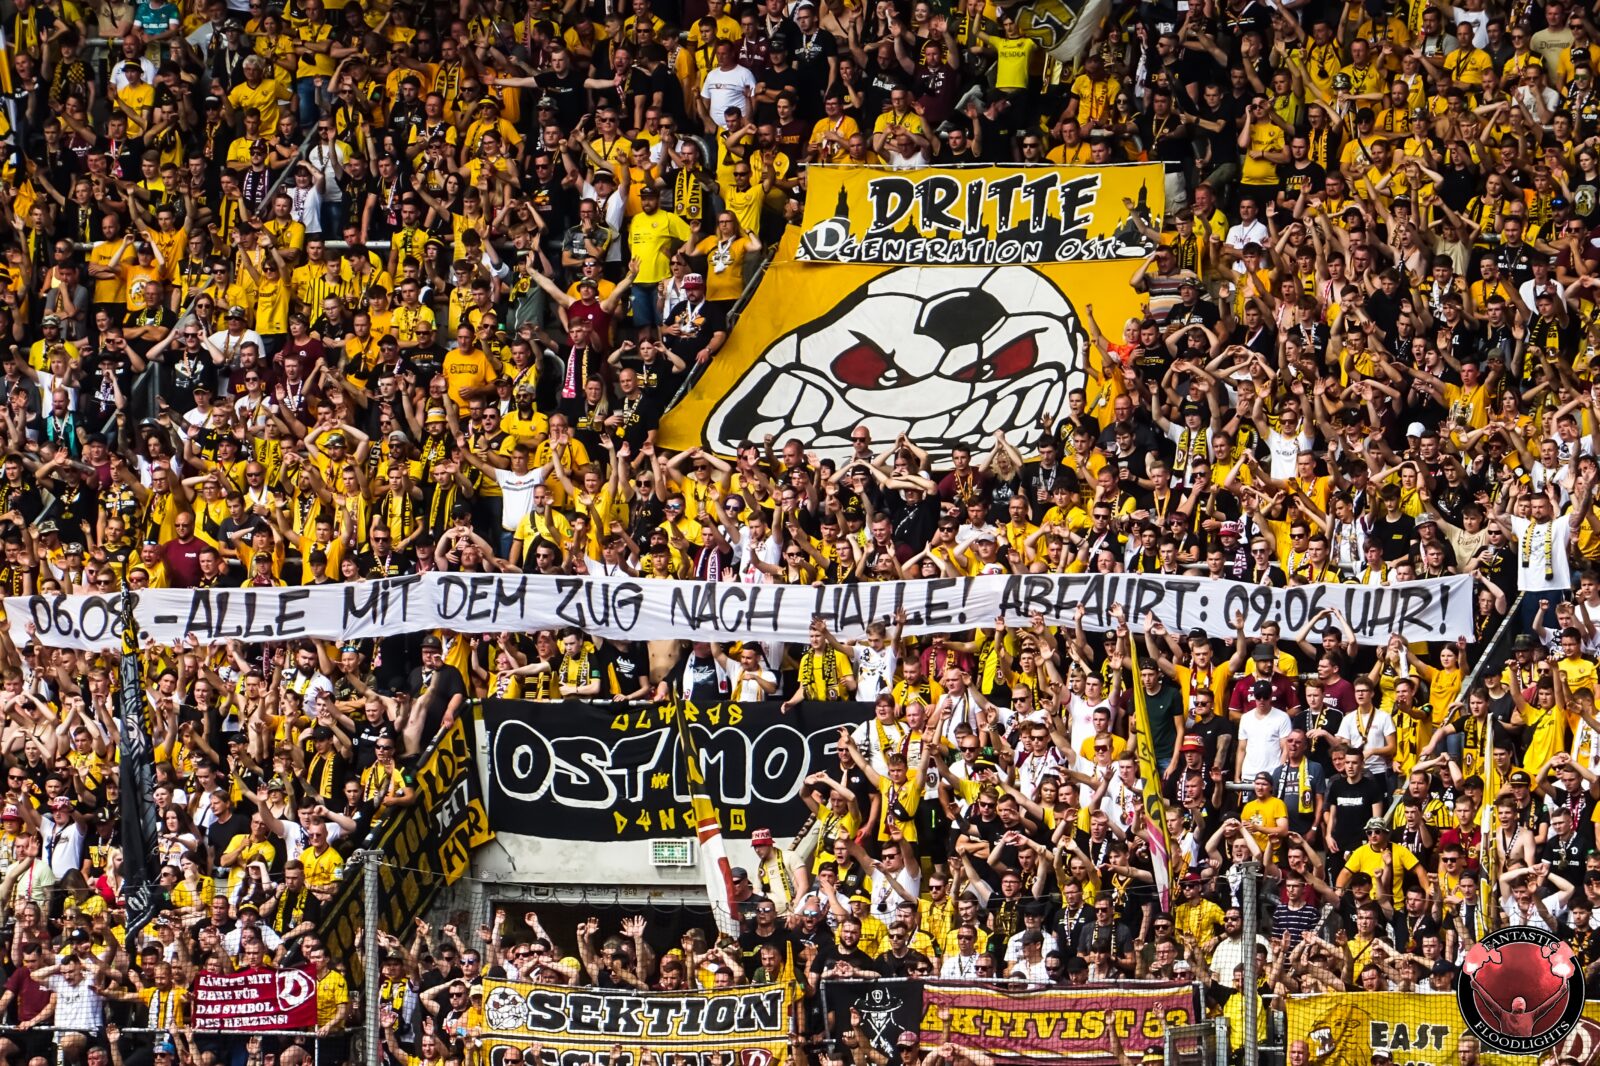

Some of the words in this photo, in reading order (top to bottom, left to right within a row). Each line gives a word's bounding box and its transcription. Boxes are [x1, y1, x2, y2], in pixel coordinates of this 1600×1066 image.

[868, 172, 1101, 236] DRITTE
[836, 234, 1043, 263] GENERATION
[1055, 237, 1118, 262] OST
[437, 575, 527, 623] DEM
[556, 577, 643, 631] ZUG
[671, 582, 785, 632] NACH
[811, 577, 974, 633] HALLE!
[1223, 585, 1329, 635] 09:06
[1344, 583, 1450, 636] UHR!
[614, 808, 747, 834] DYNAO
[197, 990, 232, 1001] EHRE
[234, 988, 259, 1000] FÜR
[198, 974, 245, 987] KÄMPFE
[247, 973, 272, 985] MIT
[195, 1018, 221, 1028] DES
[223, 1014, 288, 1028] HERZENS!
[196, 1004, 221, 1014] DAS
[222, 1001, 274, 1015] SYMBOL
[526, 988, 785, 1036] SEKTION
[919, 1003, 1136, 1040] AKTIVIST
[1369, 1021, 1450, 1051] EAST
